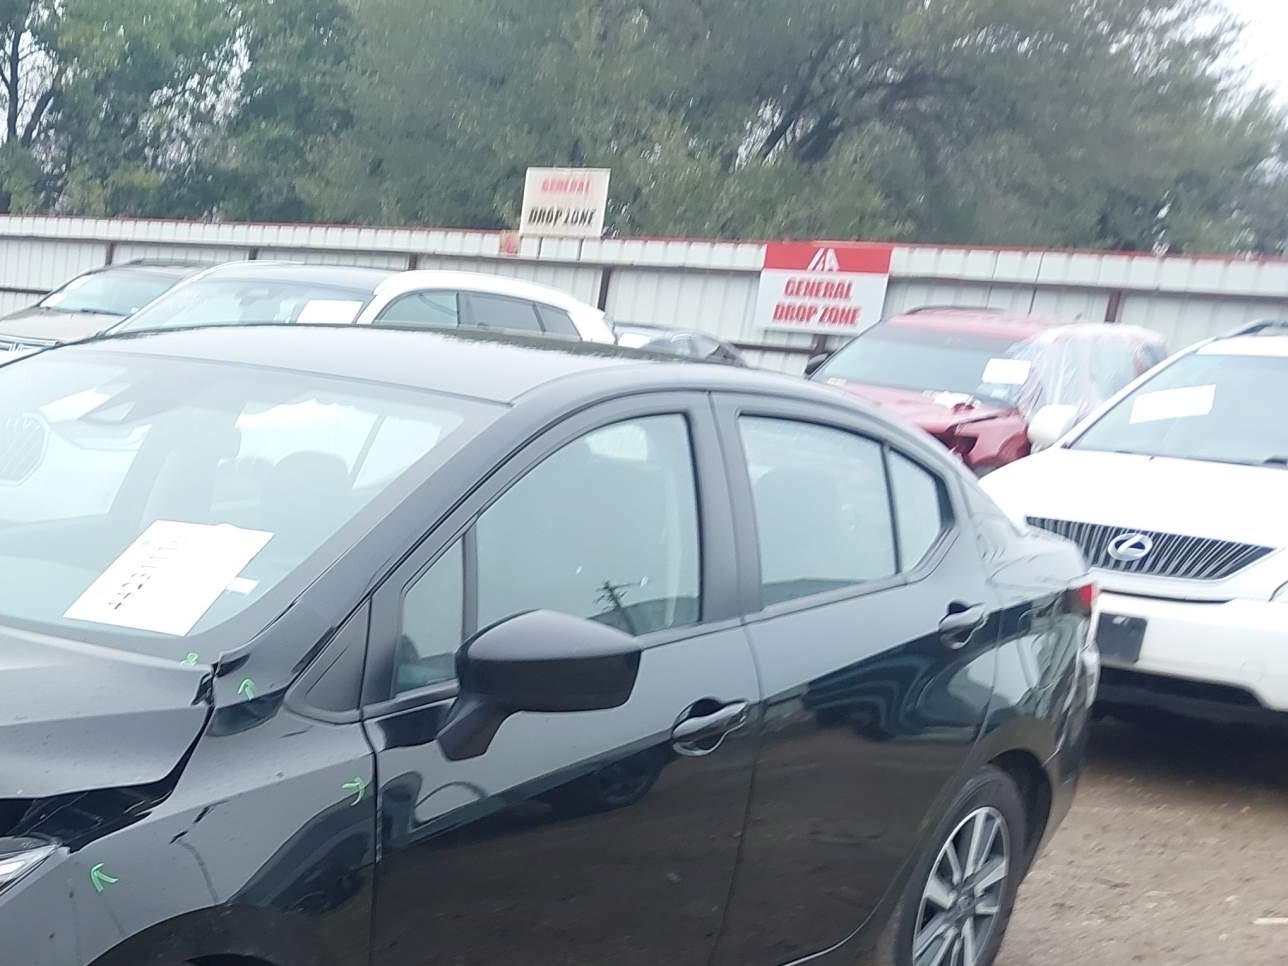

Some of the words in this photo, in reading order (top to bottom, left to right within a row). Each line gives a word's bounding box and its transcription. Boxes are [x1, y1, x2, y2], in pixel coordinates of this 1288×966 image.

[542, 178, 591, 193] GENERAL
[528, 207, 562, 224] DROP
[563, 208, 597, 225] ZONE
[784, 279, 852, 300] GENERAL
[773, 304, 818, 322] DROP
[819, 306, 861, 326] ZONE
